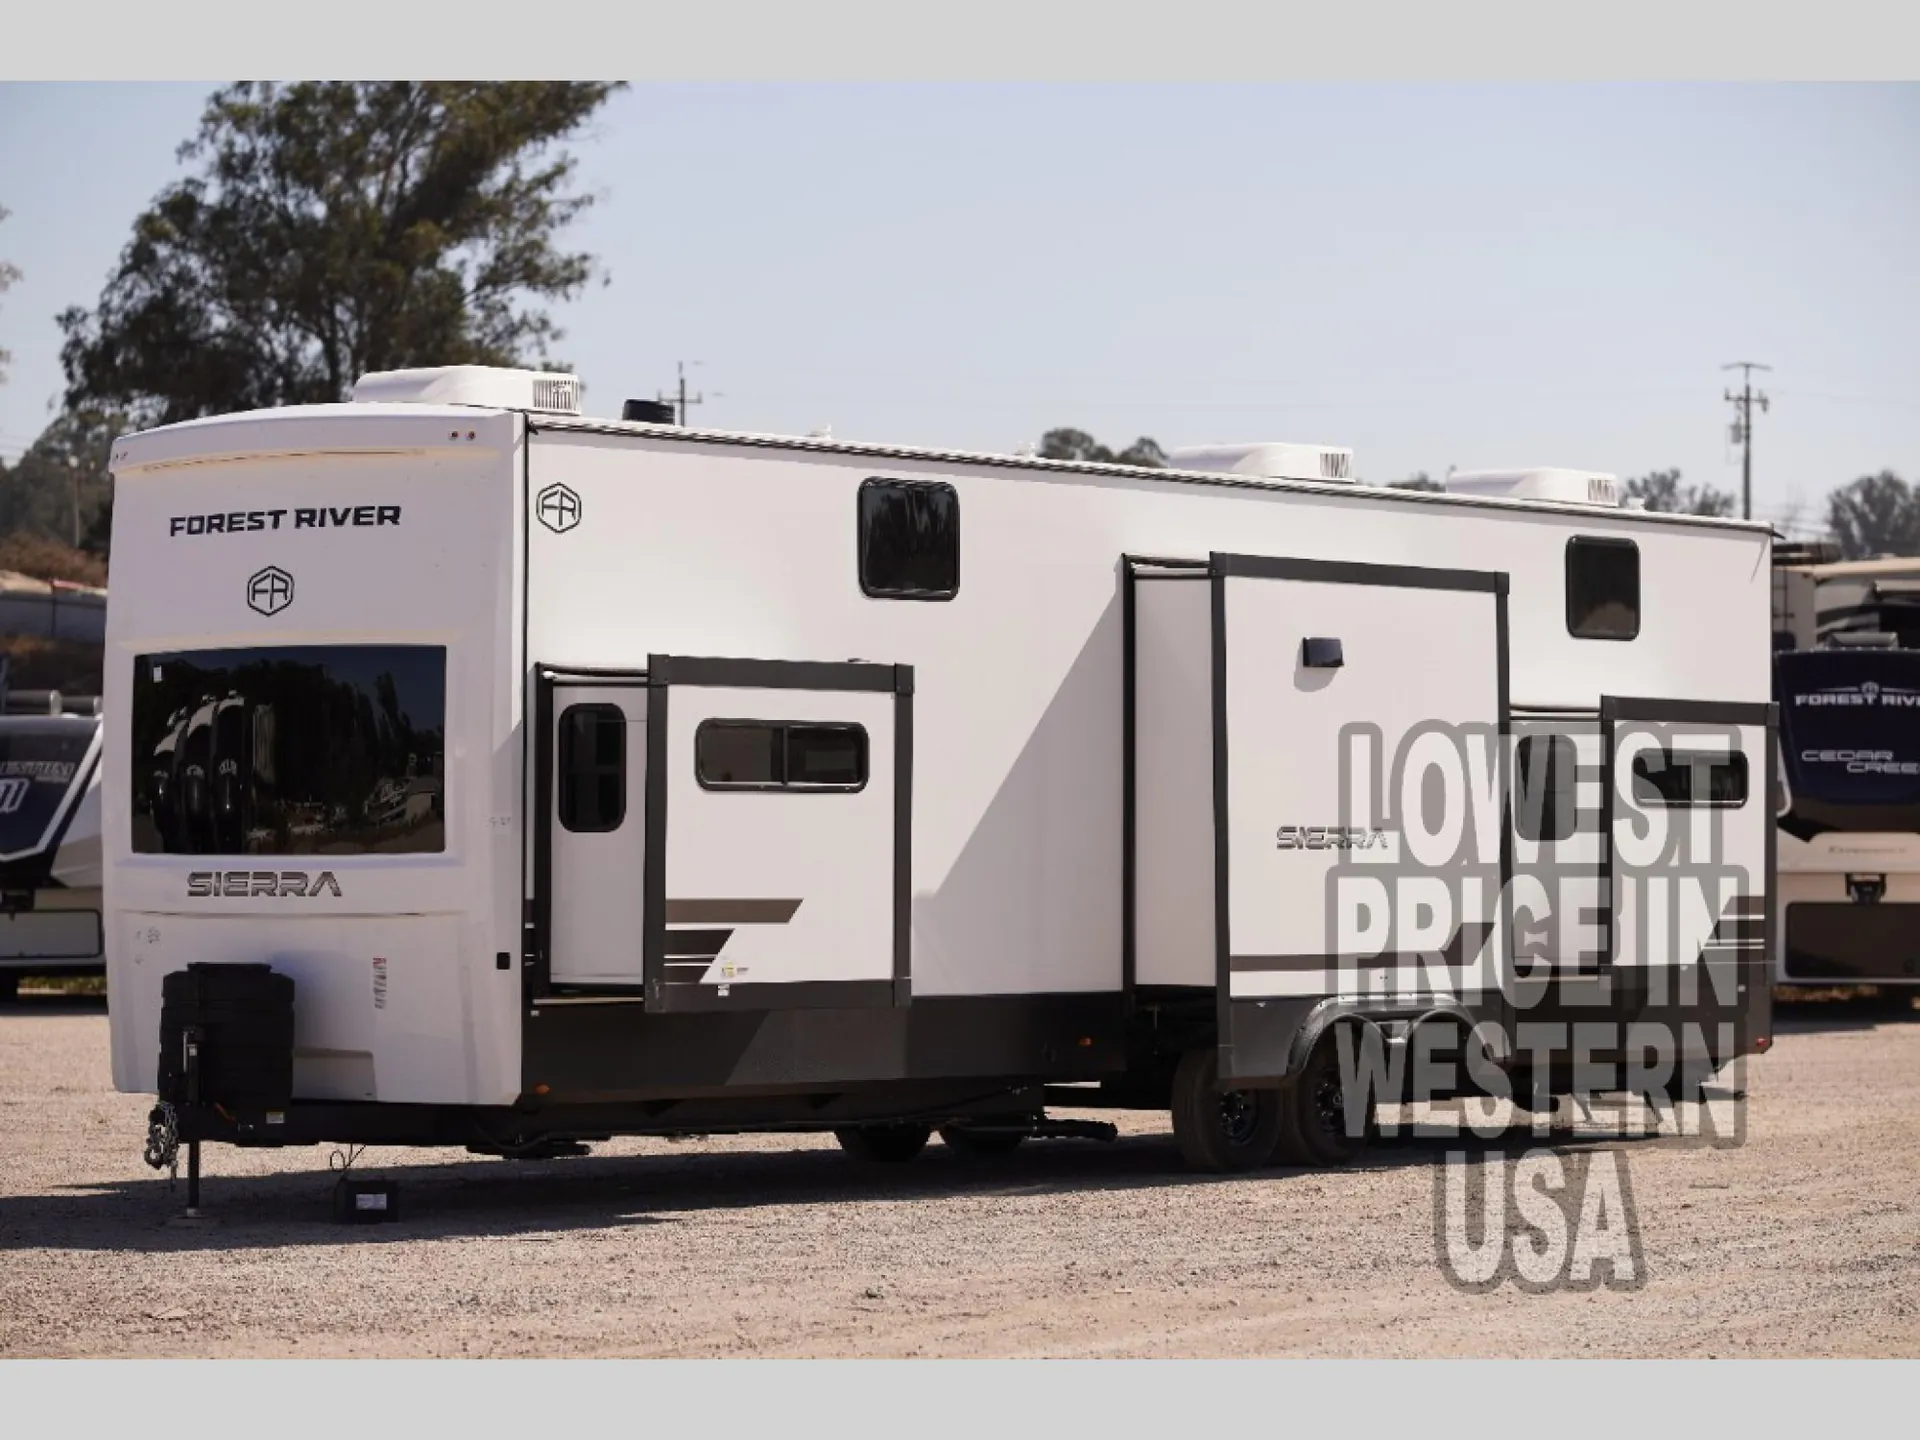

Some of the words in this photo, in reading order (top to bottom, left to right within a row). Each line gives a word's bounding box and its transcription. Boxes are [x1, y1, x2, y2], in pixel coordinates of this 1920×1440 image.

[170, 510, 287, 536] FOREST
[294, 506, 401, 528] RIVER
[1795, 693, 1875, 706] FOREST
[1801, 749, 1893, 762] CEDAR
[1846, 762, 1920, 774] CREE
[1276, 826, 1388, 850] SIERRA
[187, 871, 342, 897] SIERRA
